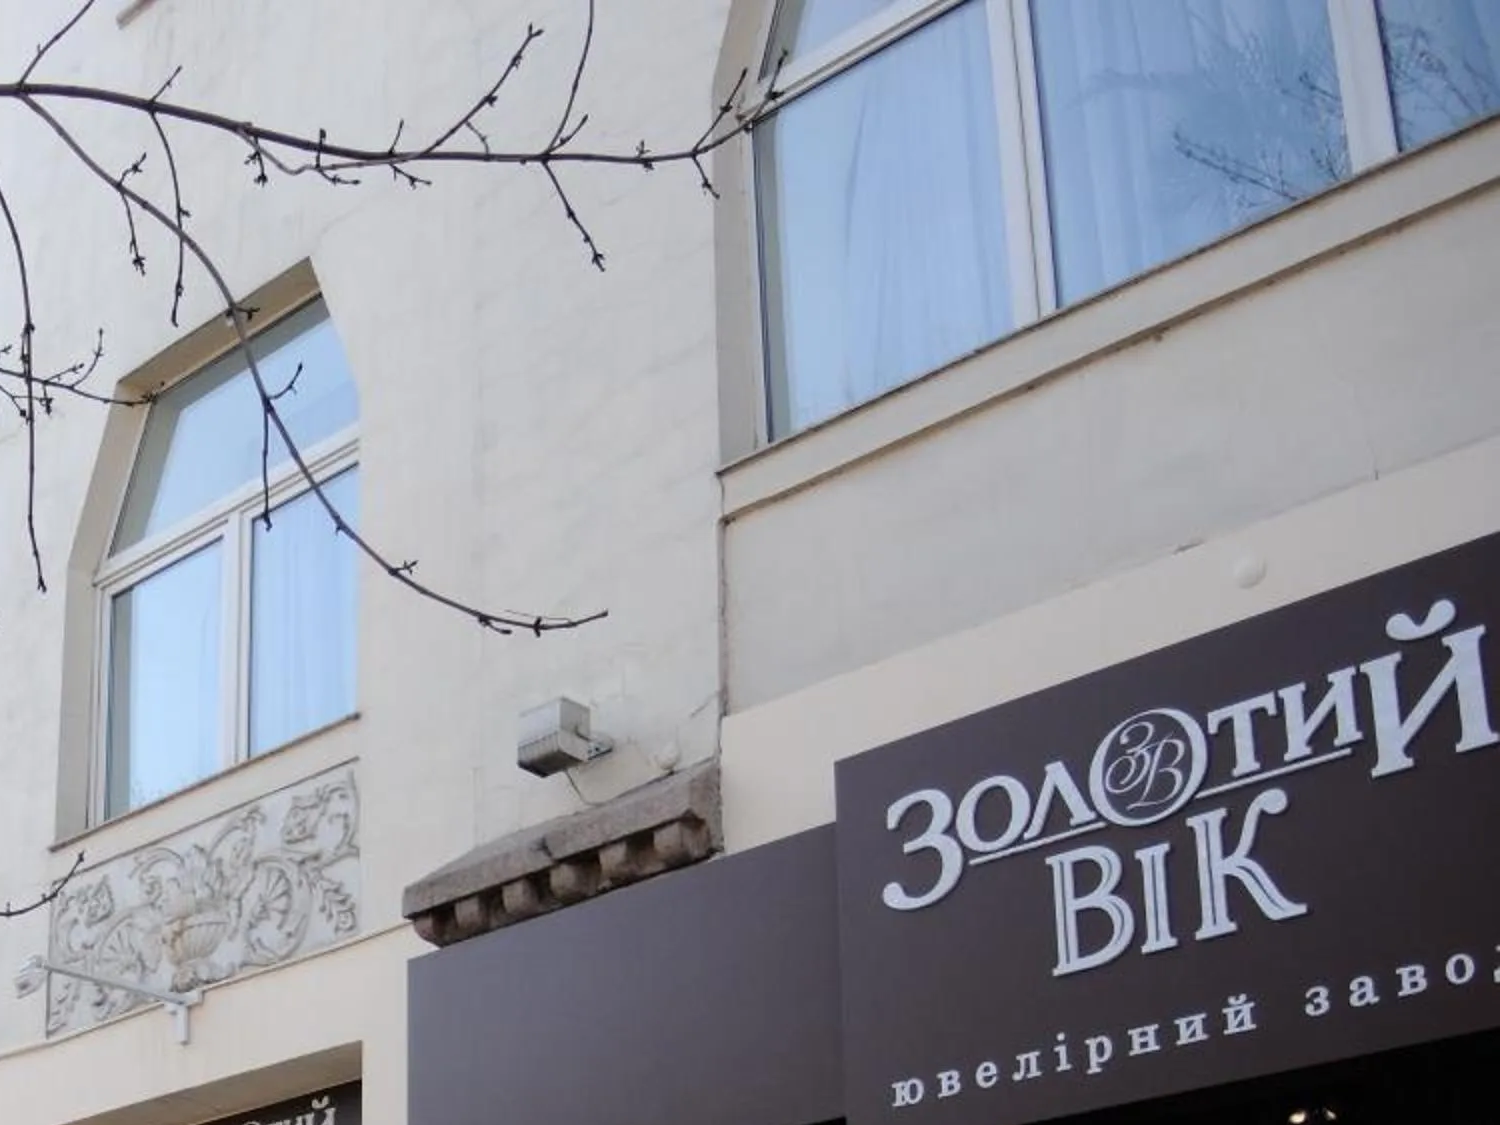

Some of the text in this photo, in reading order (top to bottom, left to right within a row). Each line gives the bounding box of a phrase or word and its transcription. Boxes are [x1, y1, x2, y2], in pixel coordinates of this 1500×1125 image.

[882, 599, 1500, 910] ЗОЛОТИЙ
[1046, 788, 1307, 977] ВІК
[891, 945, 1500, 1108] ювелірний заво
